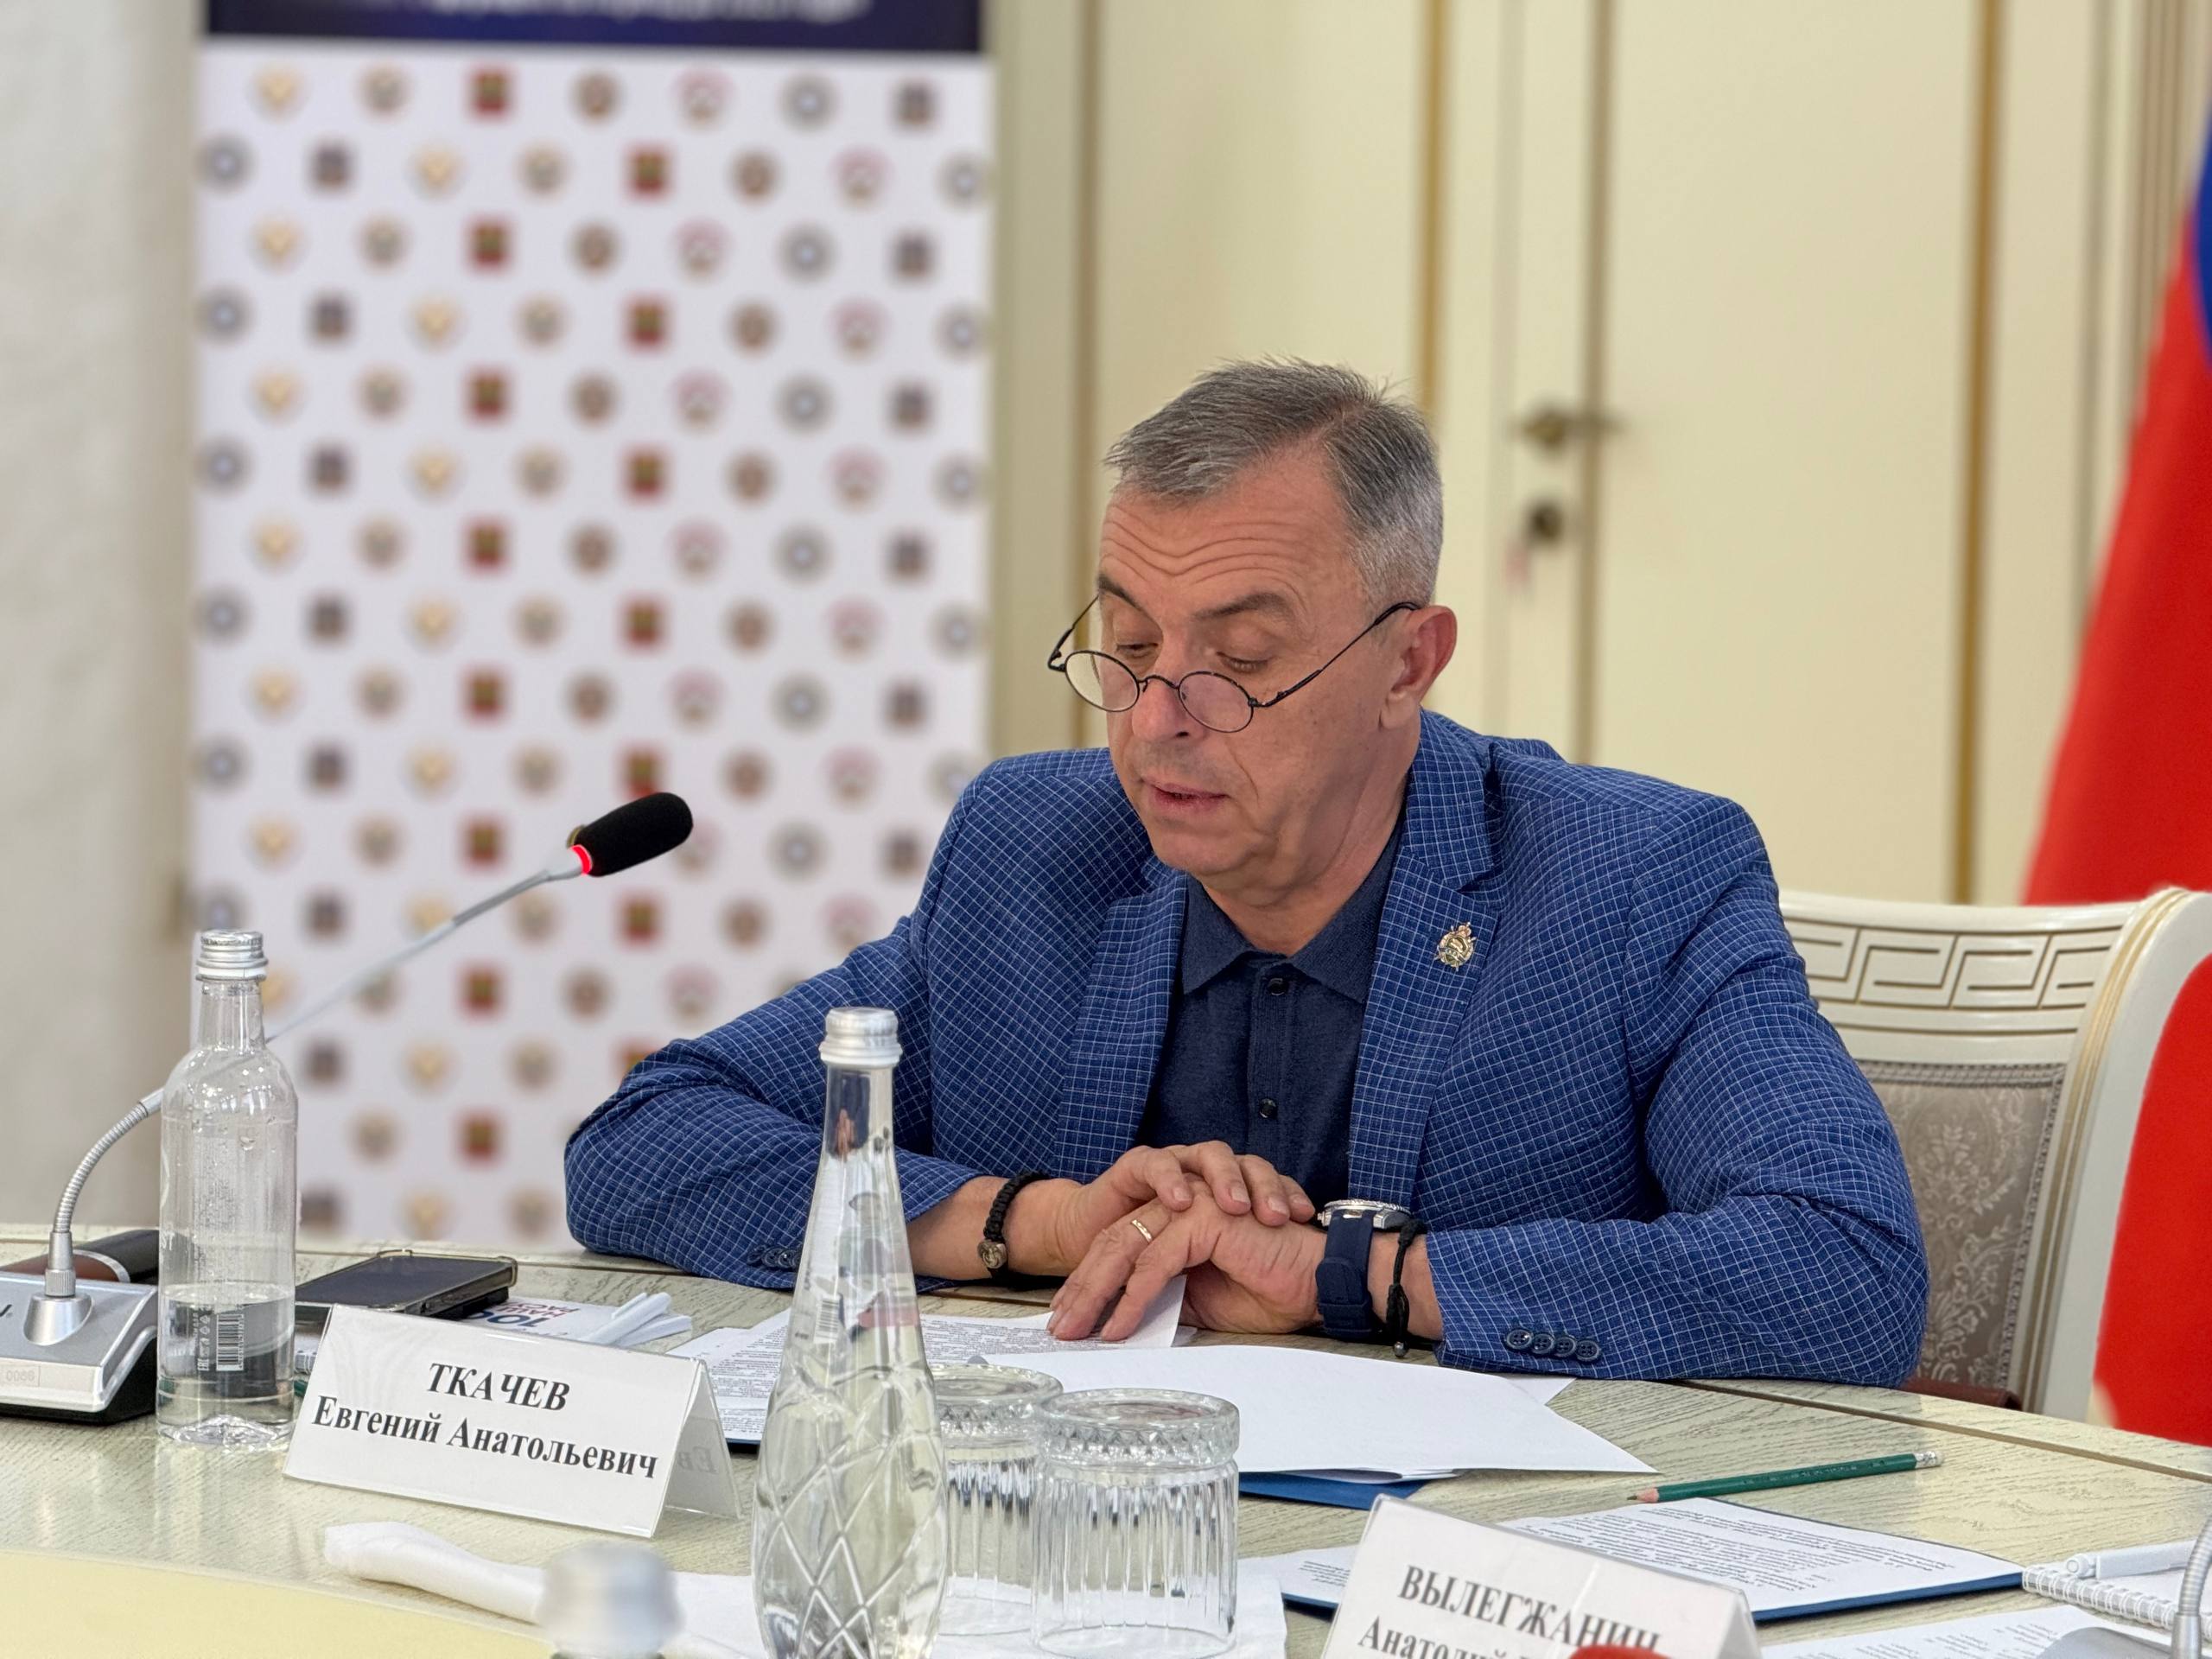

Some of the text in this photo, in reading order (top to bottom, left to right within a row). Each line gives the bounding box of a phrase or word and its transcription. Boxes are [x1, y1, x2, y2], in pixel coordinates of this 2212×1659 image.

[426, 1363, 571, 1411] ТКАЧЕВ
[312, 1395, 659, 1478] Евгений Анатольевич
